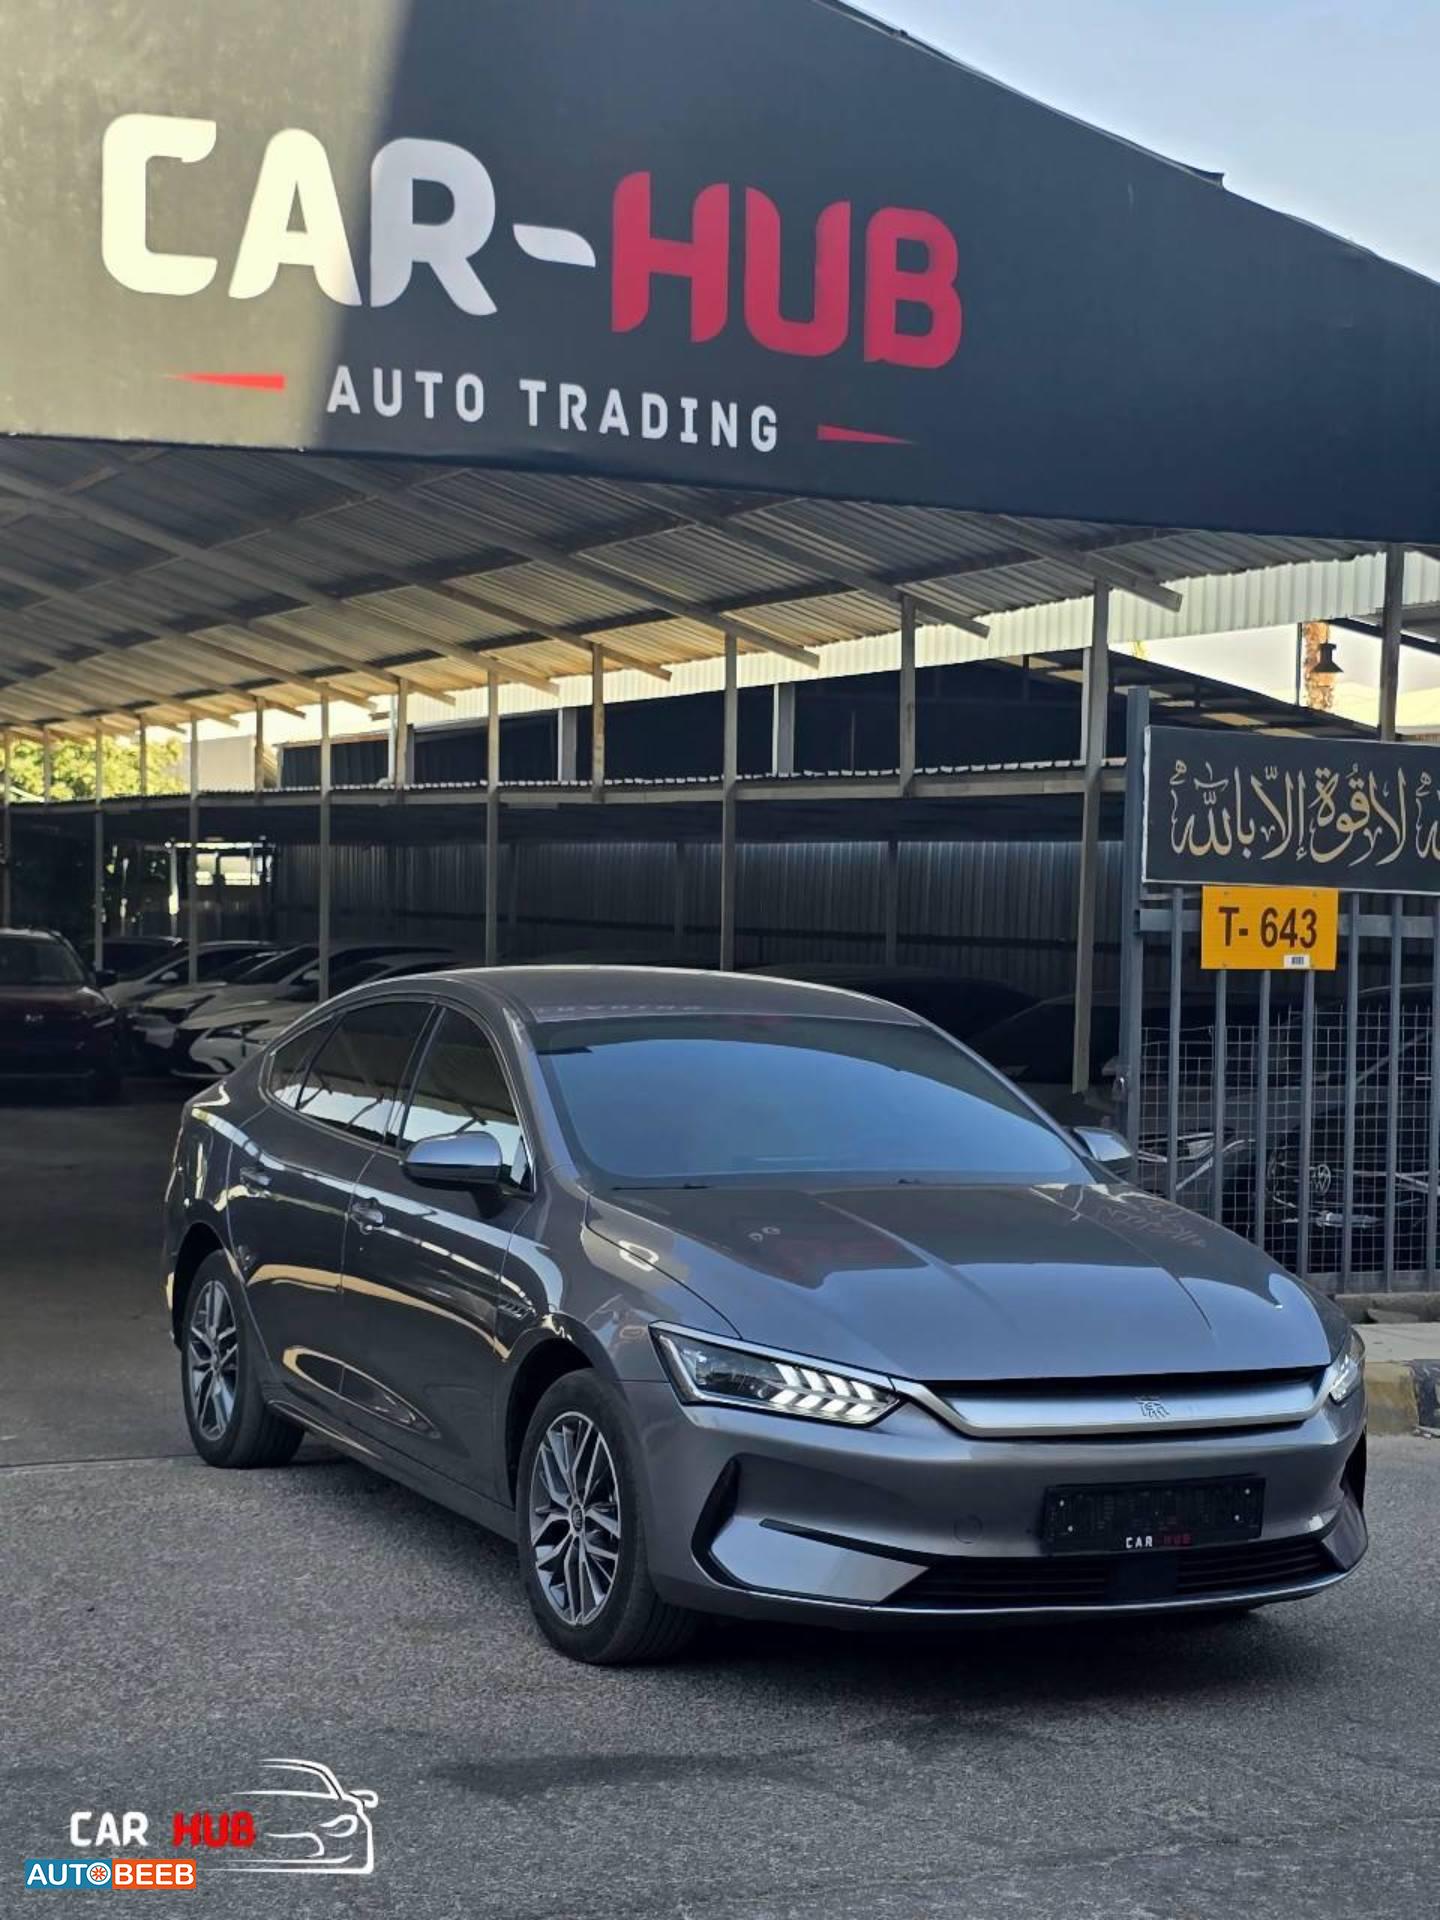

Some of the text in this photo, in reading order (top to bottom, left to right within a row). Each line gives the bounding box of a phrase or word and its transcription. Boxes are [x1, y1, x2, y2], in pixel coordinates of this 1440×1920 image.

[327, 364, 780, 453] AUTO TRADING
[1218, 906, 1318, 949] T- 643
[1125, 1535, 1153, 1549] CAR
